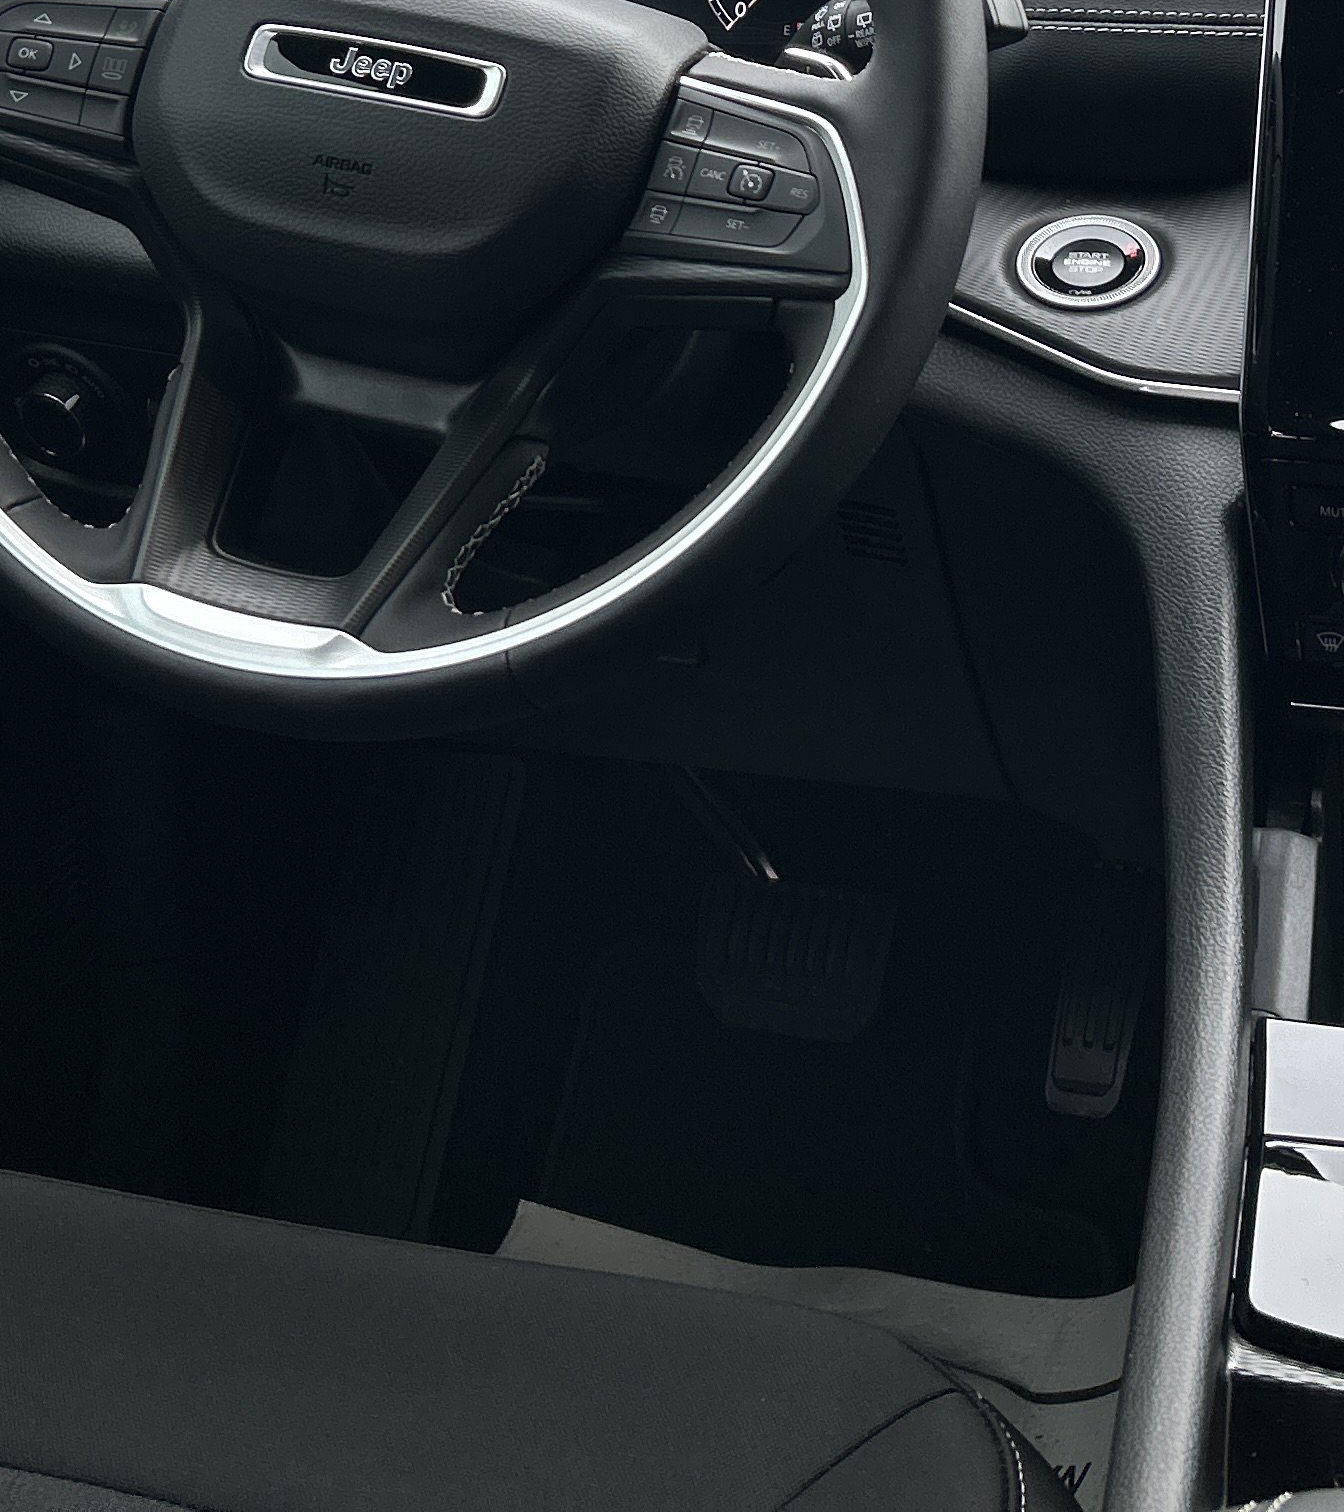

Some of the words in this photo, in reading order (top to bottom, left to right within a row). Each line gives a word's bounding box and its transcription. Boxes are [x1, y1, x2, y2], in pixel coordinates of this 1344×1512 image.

[734, 1, 747, 18] 0
[783, 24, 791, 36] E
[18, 47, 39, 60] OK
[329, 47, 413, 89] Jeep
[312, 154, 374, 176] AIRBAG
[700, 167, 726, 181] CANC
[790, 187, 809, 200] RES
[1068, 251, 1110, 260] START
[1063, 258, 1112, 267] ENGINE
[1068, 266, 1104, 274] STOP
